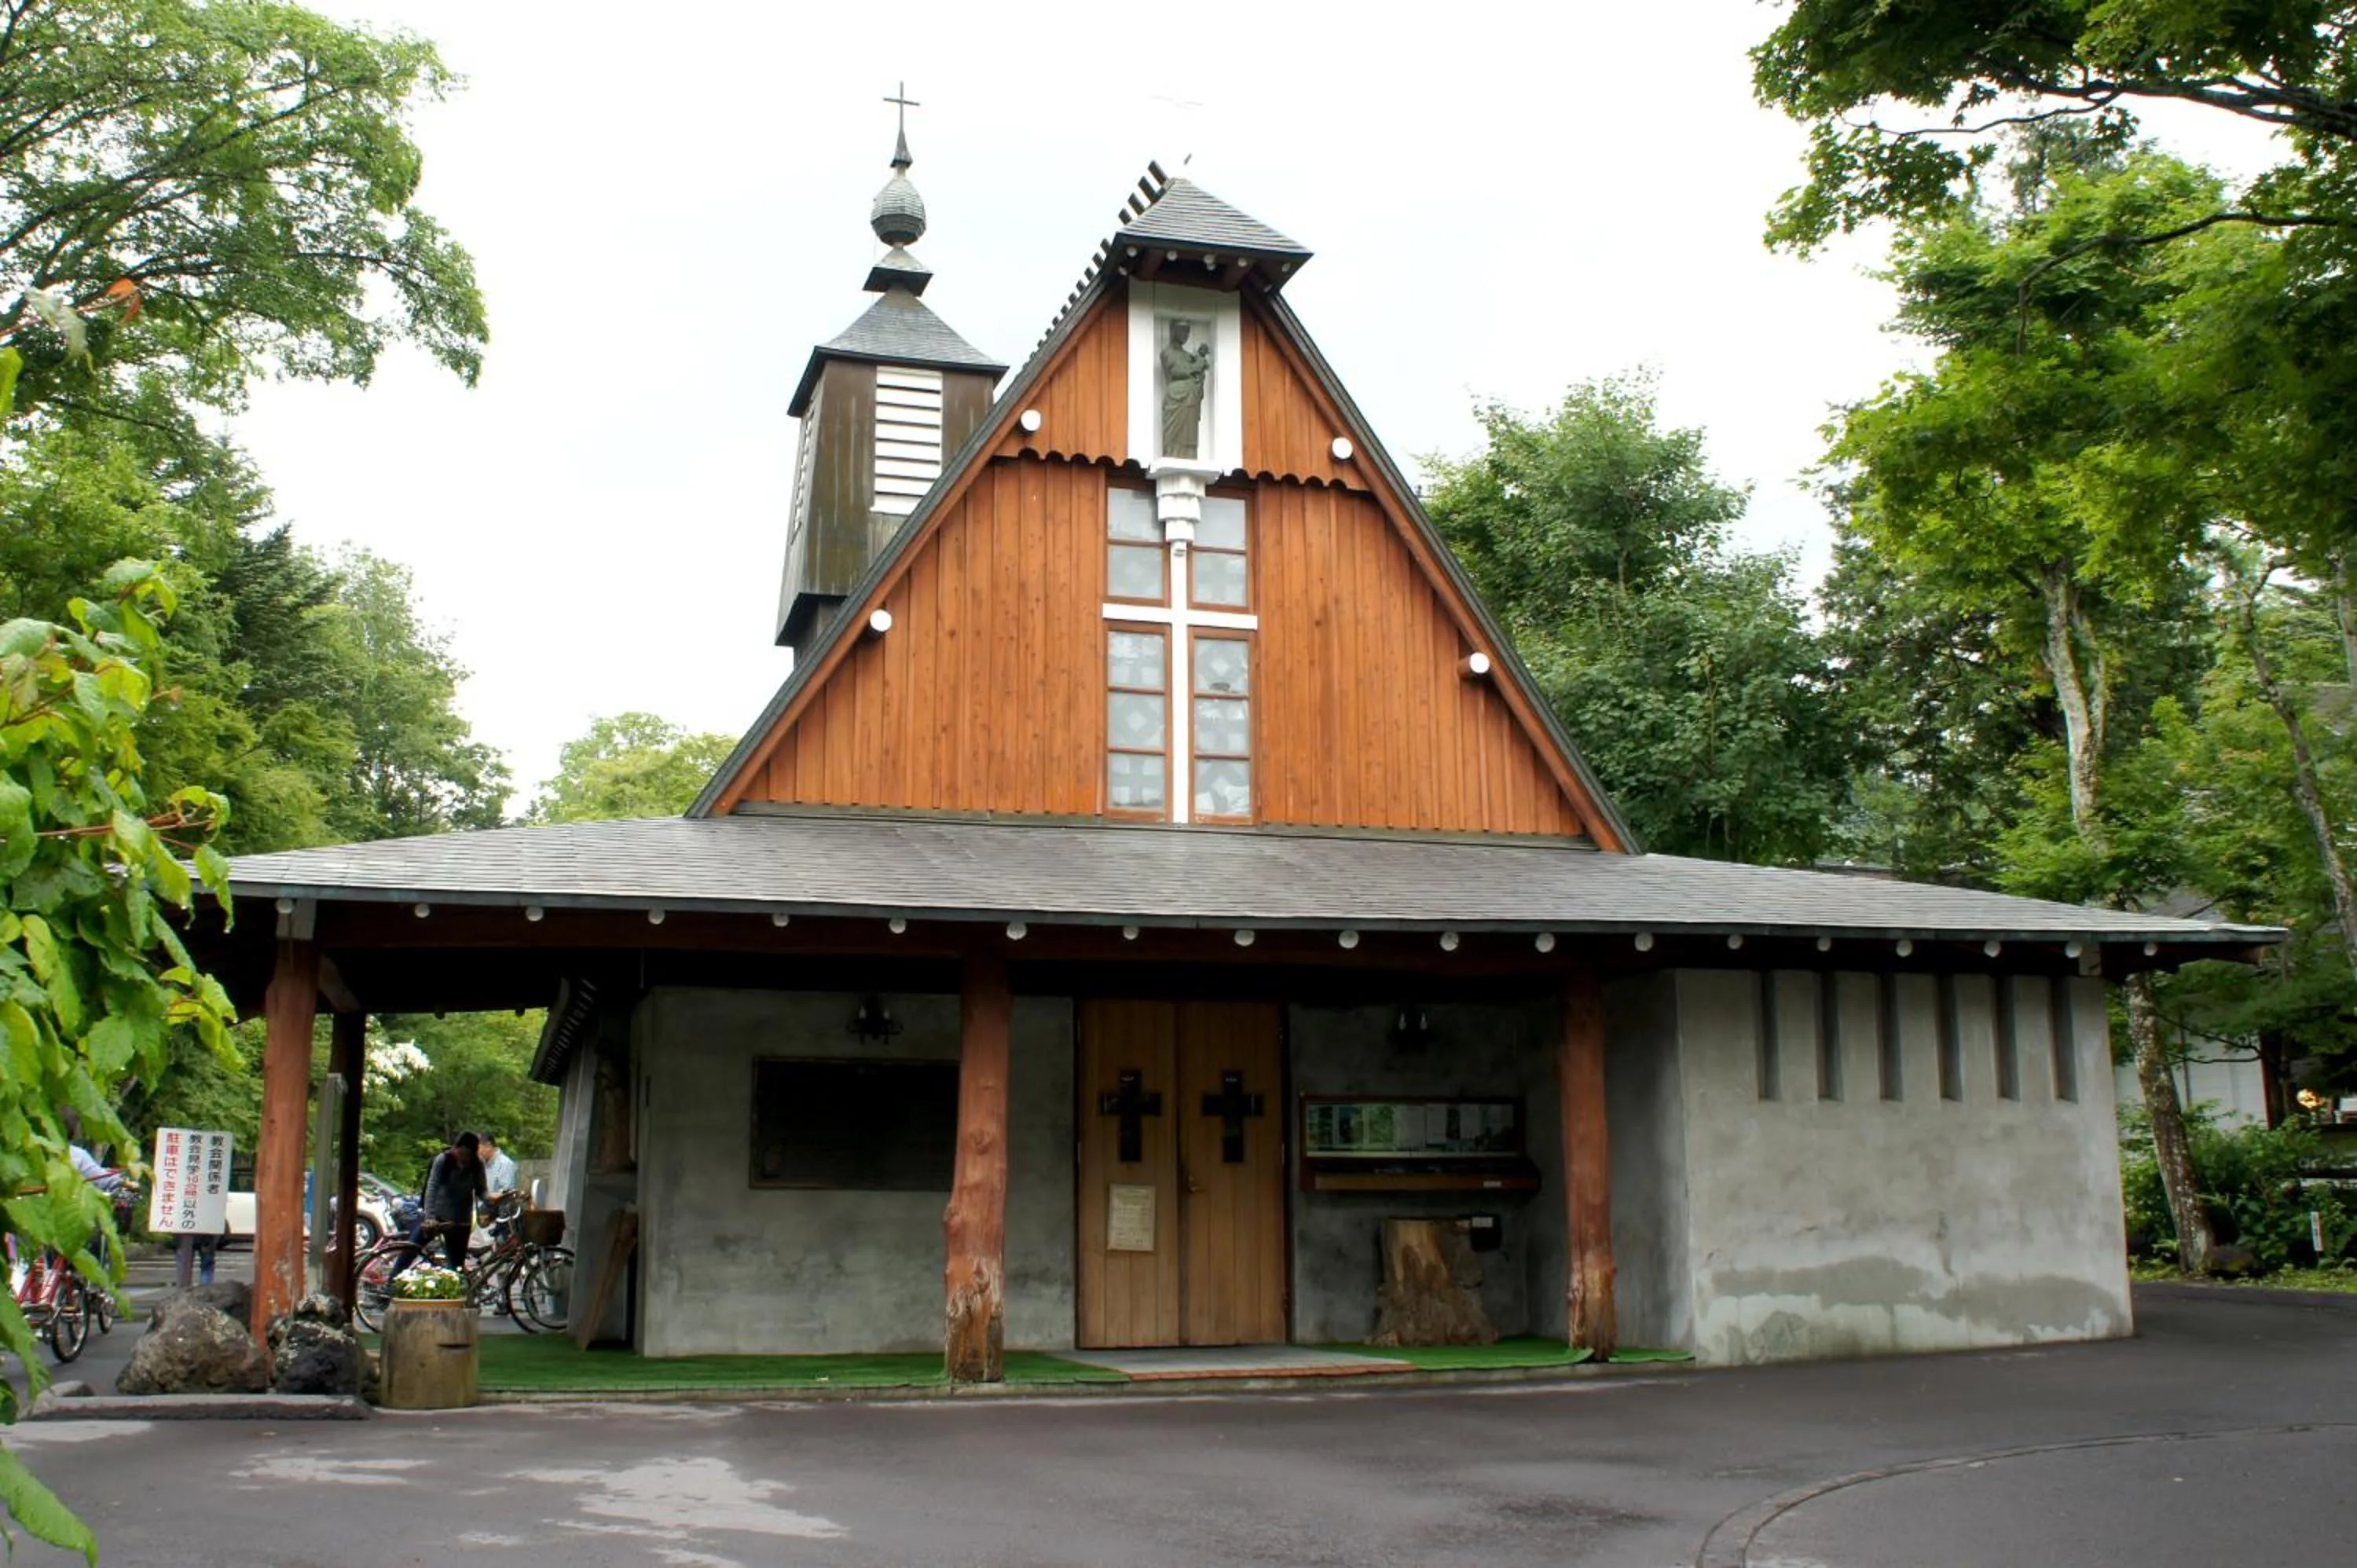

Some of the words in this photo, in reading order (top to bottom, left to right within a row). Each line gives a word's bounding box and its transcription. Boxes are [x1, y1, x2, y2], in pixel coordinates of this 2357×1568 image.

[159, 1132, 181, 1227] 駐車はできません
[207, 1135, 225, 1194] 教会関係者
